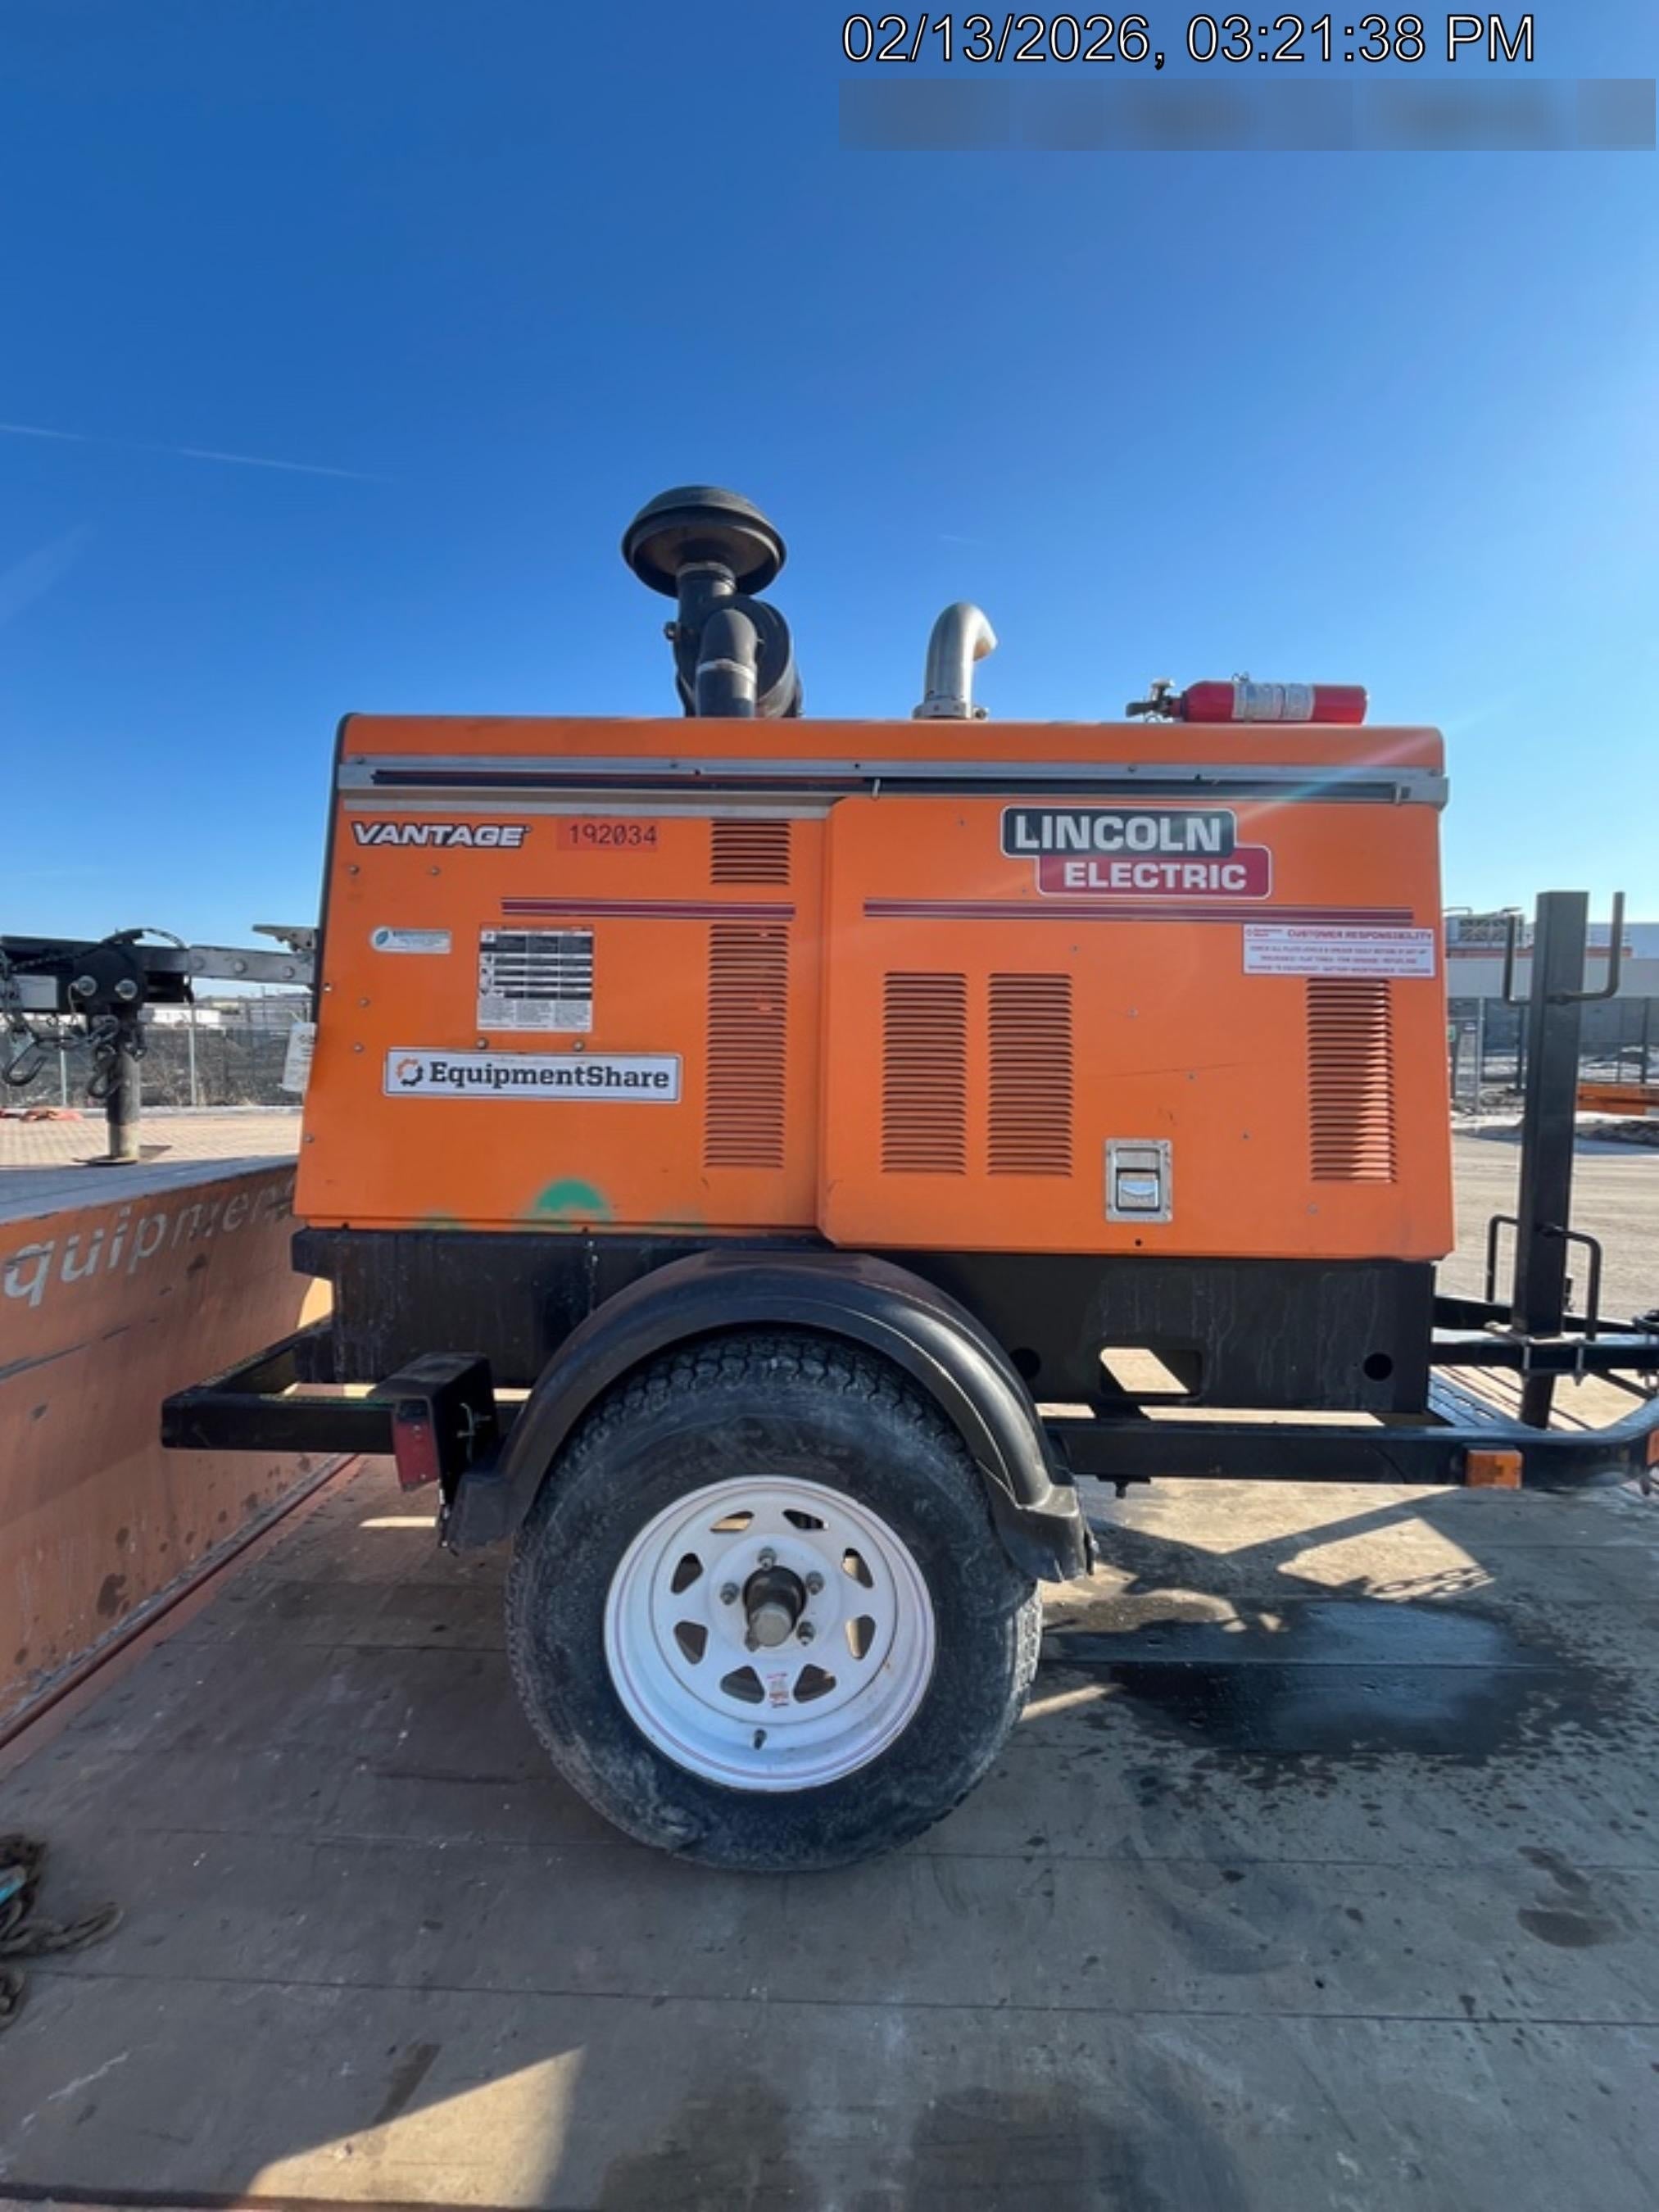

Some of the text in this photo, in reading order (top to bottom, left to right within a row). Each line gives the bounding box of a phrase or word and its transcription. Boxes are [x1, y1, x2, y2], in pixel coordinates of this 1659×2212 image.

[352, 823, 528, 847] VANTAGE
[569, 825, 657, 846] 192034
[1015, 815, 1221, 851] LINCOLN
[1064, 862, 1247, 890] ELECTRIC
[428, 1061, 669, 1089] EquipmentShare
